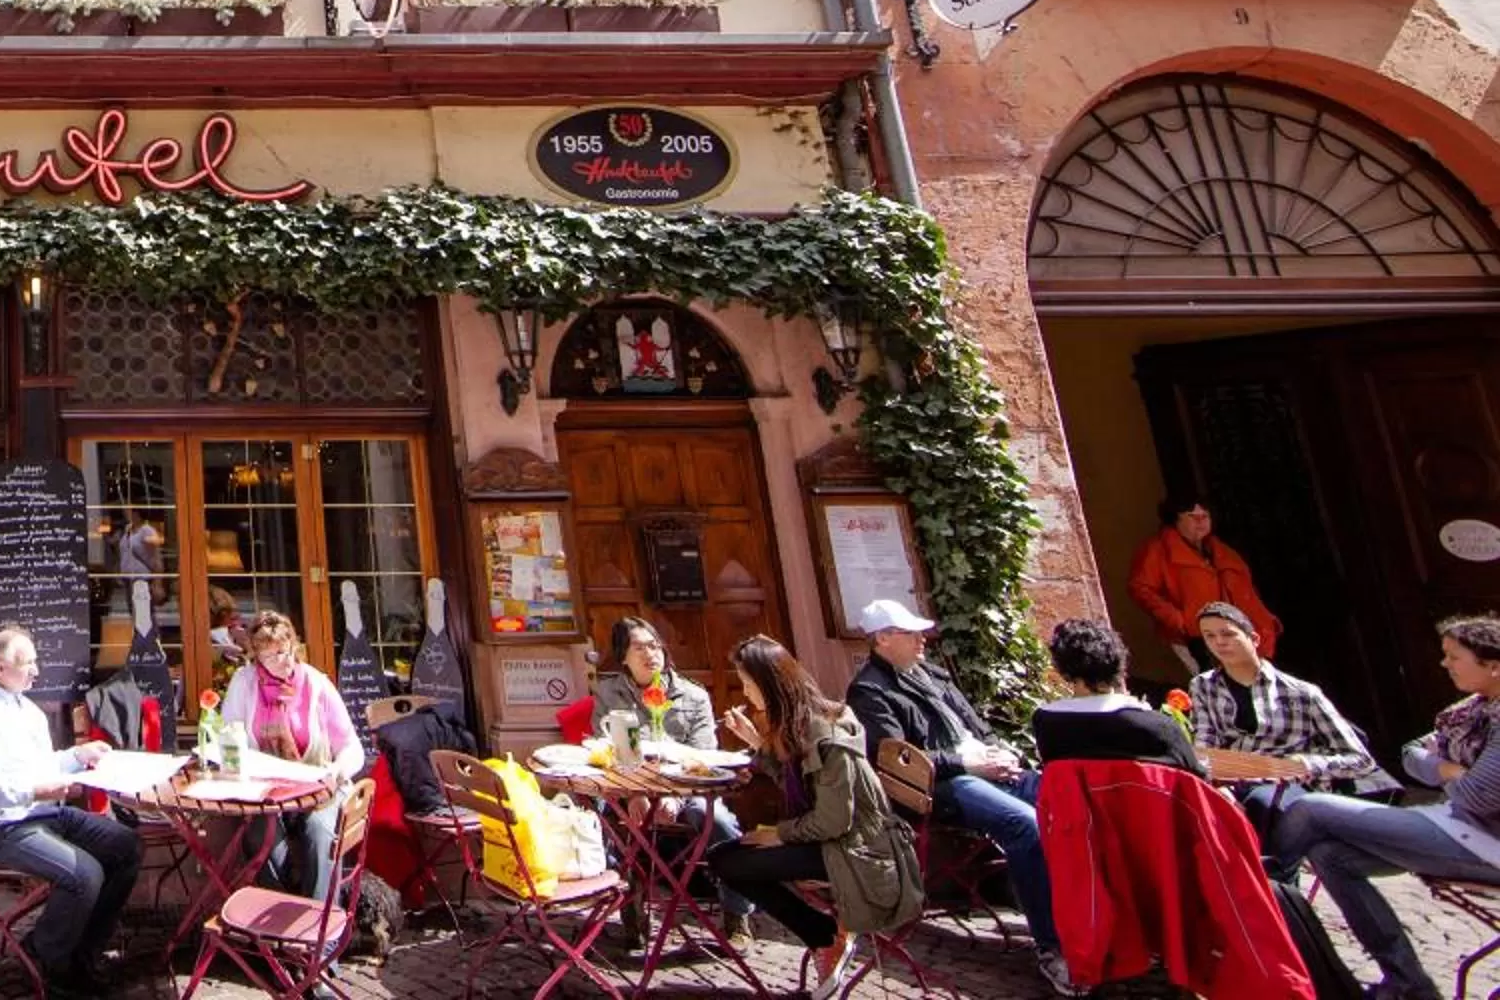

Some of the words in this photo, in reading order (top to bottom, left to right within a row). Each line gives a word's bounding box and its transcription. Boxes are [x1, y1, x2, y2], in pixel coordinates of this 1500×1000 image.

[619, 114, 644, 136] 50
[550, 135, 603, 153] 1955
[660, 135, 713, 153] 2005
[572, 155, 693, 186] Hackteufel
[605, 187, 679, 199] Gastronomie
